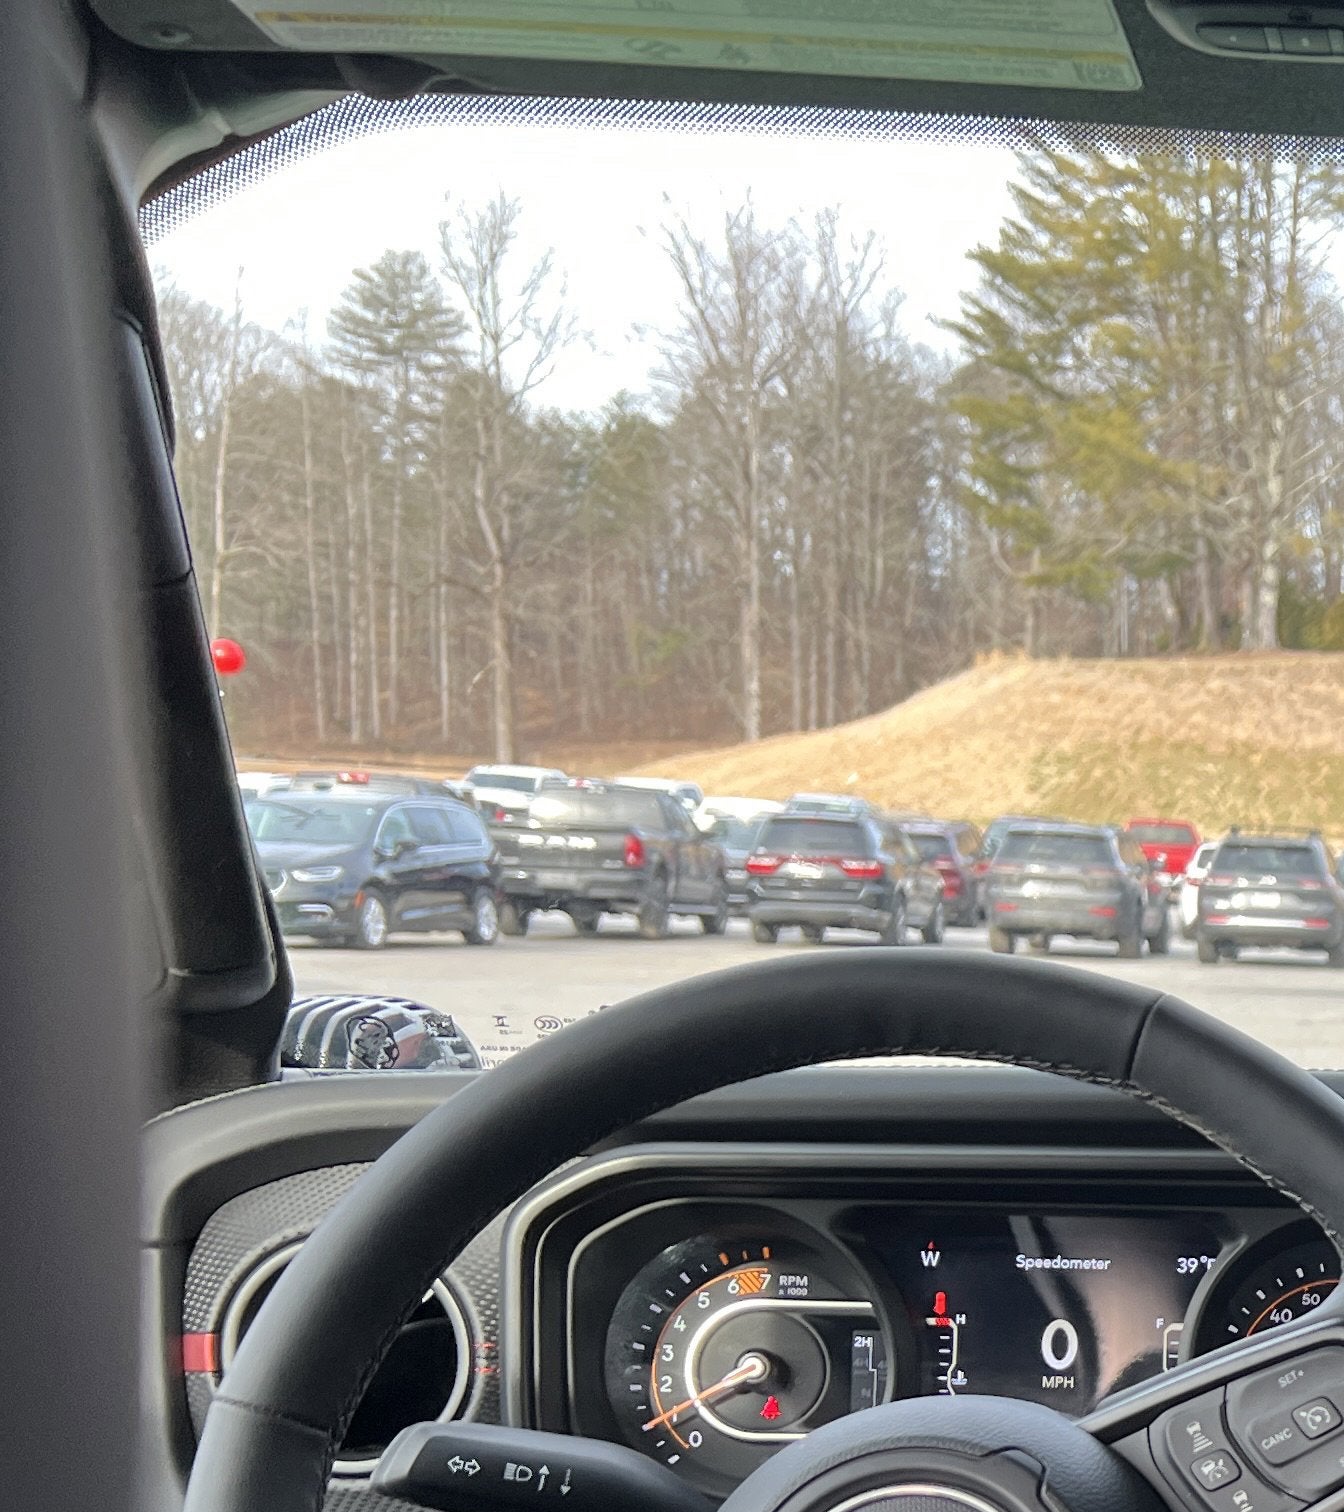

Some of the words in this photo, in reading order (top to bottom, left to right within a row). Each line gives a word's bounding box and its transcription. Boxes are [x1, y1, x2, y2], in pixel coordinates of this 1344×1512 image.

[921, 1251, 940, 1267] W
[1015, 1254, 1111, 1272] Speedometer
[727, 1279, 739, 1294] 6
[761, 1274, 771, 1289] 7
[779, 1275, 808, 1287] RPM
[698, 1292, 710, 1309] 5
[1302, 1292, 1320, 1306] 50
[674, 1316, 686, 1331] 4
[955, 1314, 966, 1325] H
[1156, 1318, 1164, 1329] F
[1270, 1308, 1293, 1324] 40
[853, 1335, 870, 1347] 2H
[1041, 1319, 1079, 1370] 0
[662, 1345, 674, 1361] 3
[660, 1376, 672, 1392] 2
[1042, 1375, 1074, 1389] MPH
[689, 1431, 702, 1447] 0
[1262, 1428, 1292, 1450] CANC
